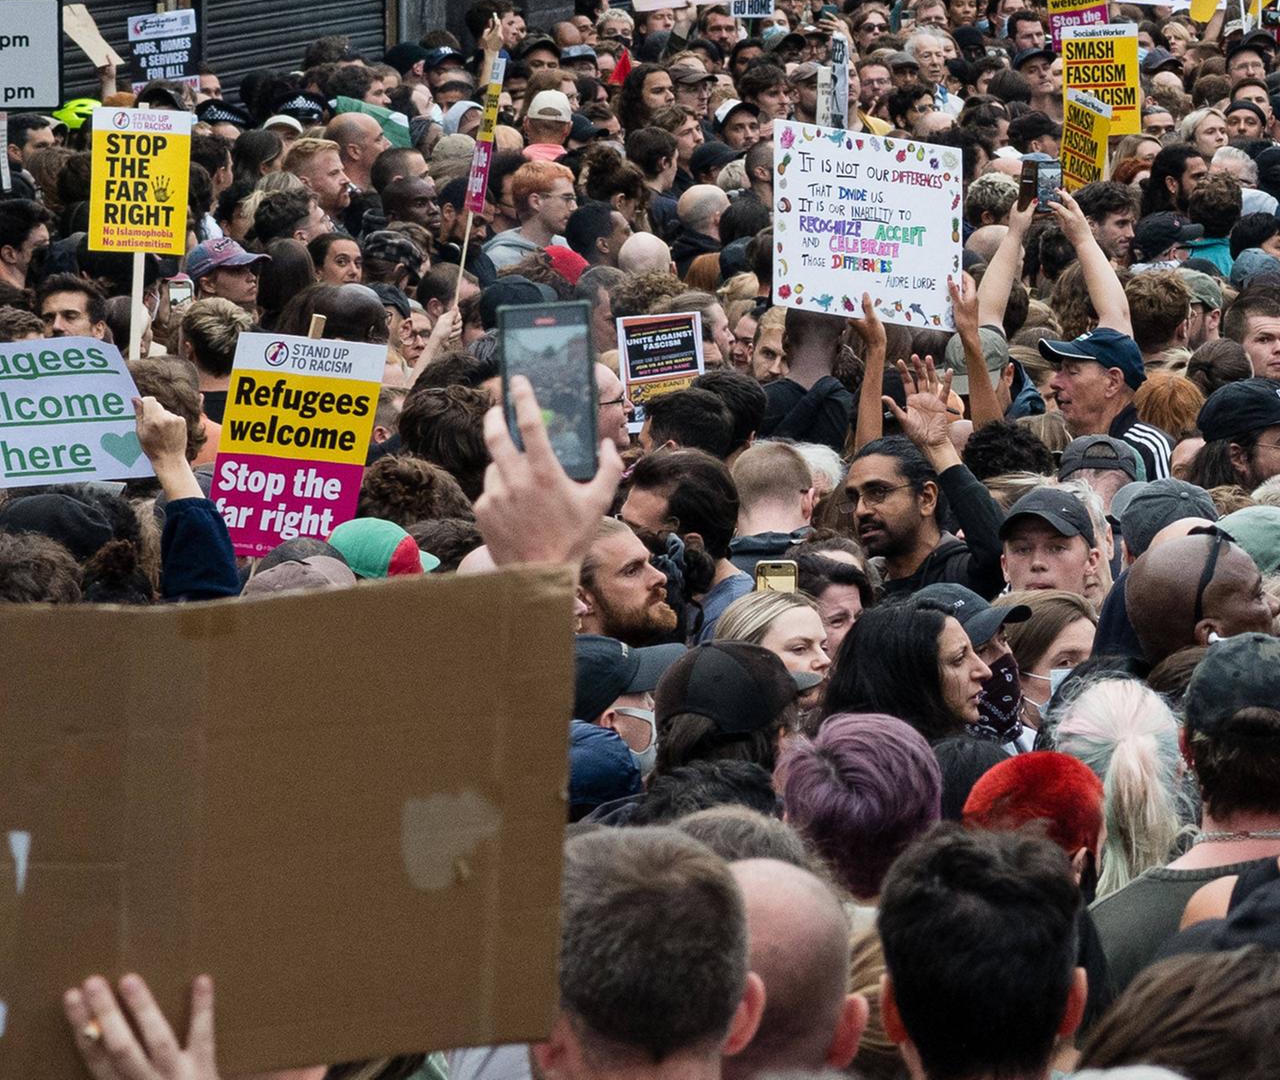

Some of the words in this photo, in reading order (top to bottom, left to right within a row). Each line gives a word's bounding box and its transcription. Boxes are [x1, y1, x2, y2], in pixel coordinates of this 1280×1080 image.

[733, 0, 746, 14] GO
[748, 0, 772, 16] HOME
[134, 42, 156, 55] JOBS,
[160, 38, 191, 52] HOMES
[1066, 41, 1114, 61] SMASH
[140, 55, 146, 66] &
[147, 53, 189, 67] SERVICES
[147, 68, 163, 81] FOR
[165, 65, 183, 79] ALL!
[1066, 64, 1126, 84] FASCISM
[4, 84, 34, 101] pm
[132, 113, 156, 122] STAND
[158, 114, 170, 123] UP
[132, 121, 143, 129] TO
[145, 122, 173, 130] RACISM
[106, 134, 168, 157] STOP
[107, 157, 150, 180] THE
[821, 159, 832, 173] IS
[836, 161, 860, 175] NOT
[867, 167, 889, 182] OUR
[891, 170, 943, 189] DIFFERENCES
[104, 180, 147, 203] FAR
[838, 186, 867, 201] DIVIDE
[871, 192, 884, 203] US
[103, 203, 174, 228] RIGHT
[816, 201, 824, 212] IS
[829, 206, 845, 216] OUR
[852, 206, 894, 221] INABILITY
[899, 210, 911, 220] TO
[103, 226, 113, 237] No
[115, 226, 173, 240] Islamophobia
[800, 216, 861, 237] RECOGNIZE
[875, 225, 927, 246] ACCEPT
[102, 237, 112, 247] No
[114, 239, 173, 249] antisemitism
[802, 238, 820, 247] AND
[829, 235, 899, 258] CELEBRATE
[831, 255, 892, 273] DIFFERENCES
[913, 276, 936, 290] LORDE
[627, 335, 653, 346] UNITE
[656, 329, 693, 341] AGAINST
[643, 339, 681, 351] FASCISM
[292, 344, 327, 358] STAND
[330, 347, 349, 359] UP
[290, 356, 307, 370] TO
[309, 358, 352, 374] RACISM
[234, 376, 370, 418] Refugees
[2, 391, 124, 423] lcome
[230, 416, 356, 452] welcome
[1, 441, 92, 471] here
[219, 461, 285, 501] Stop
[293, 468, 341, 501] the
[260, 503, 334, 540] right
